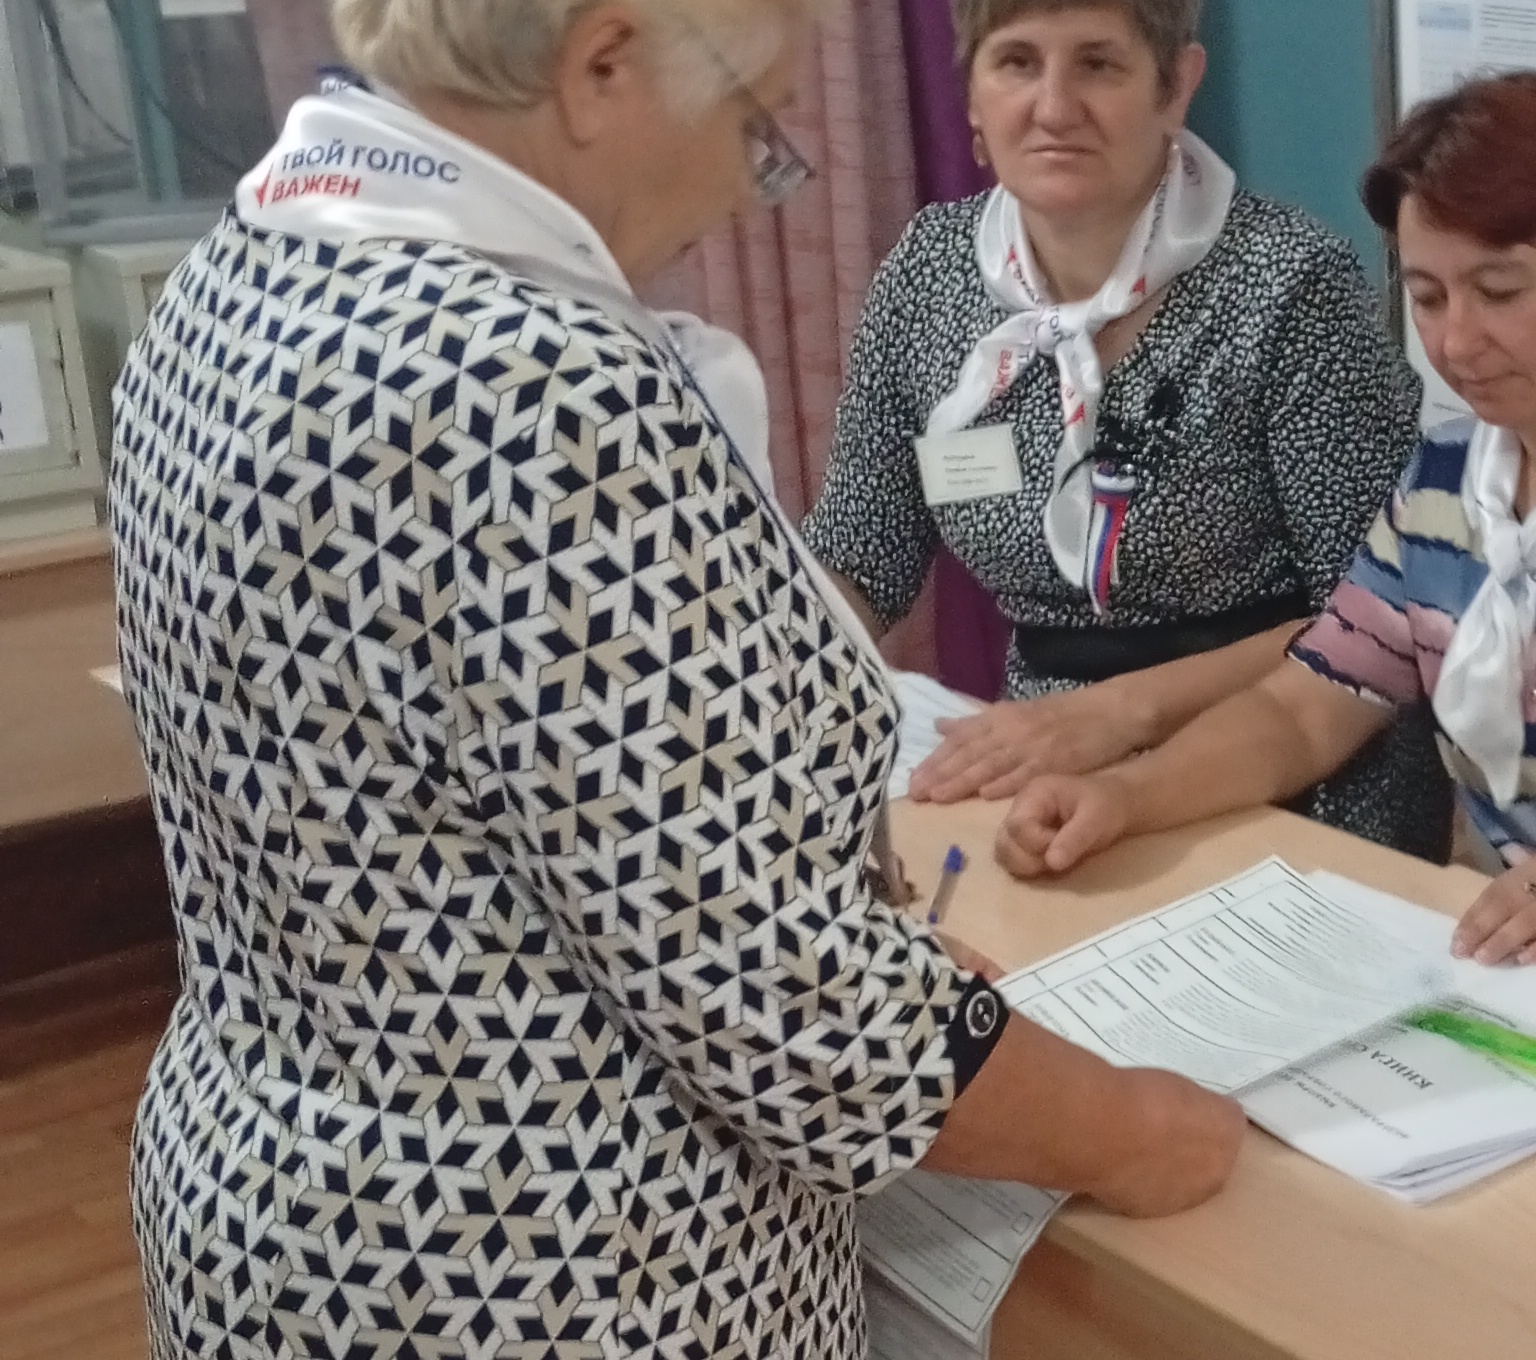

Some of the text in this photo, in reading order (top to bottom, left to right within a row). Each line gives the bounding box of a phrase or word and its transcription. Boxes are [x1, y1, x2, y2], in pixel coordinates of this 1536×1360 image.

[281, 138, 461, 183] ТВОЙ ГОЛОС
[271, 174, 362, 203] ВАЖЕН
[1369, 1050, 1434, 1090] КНИГА
